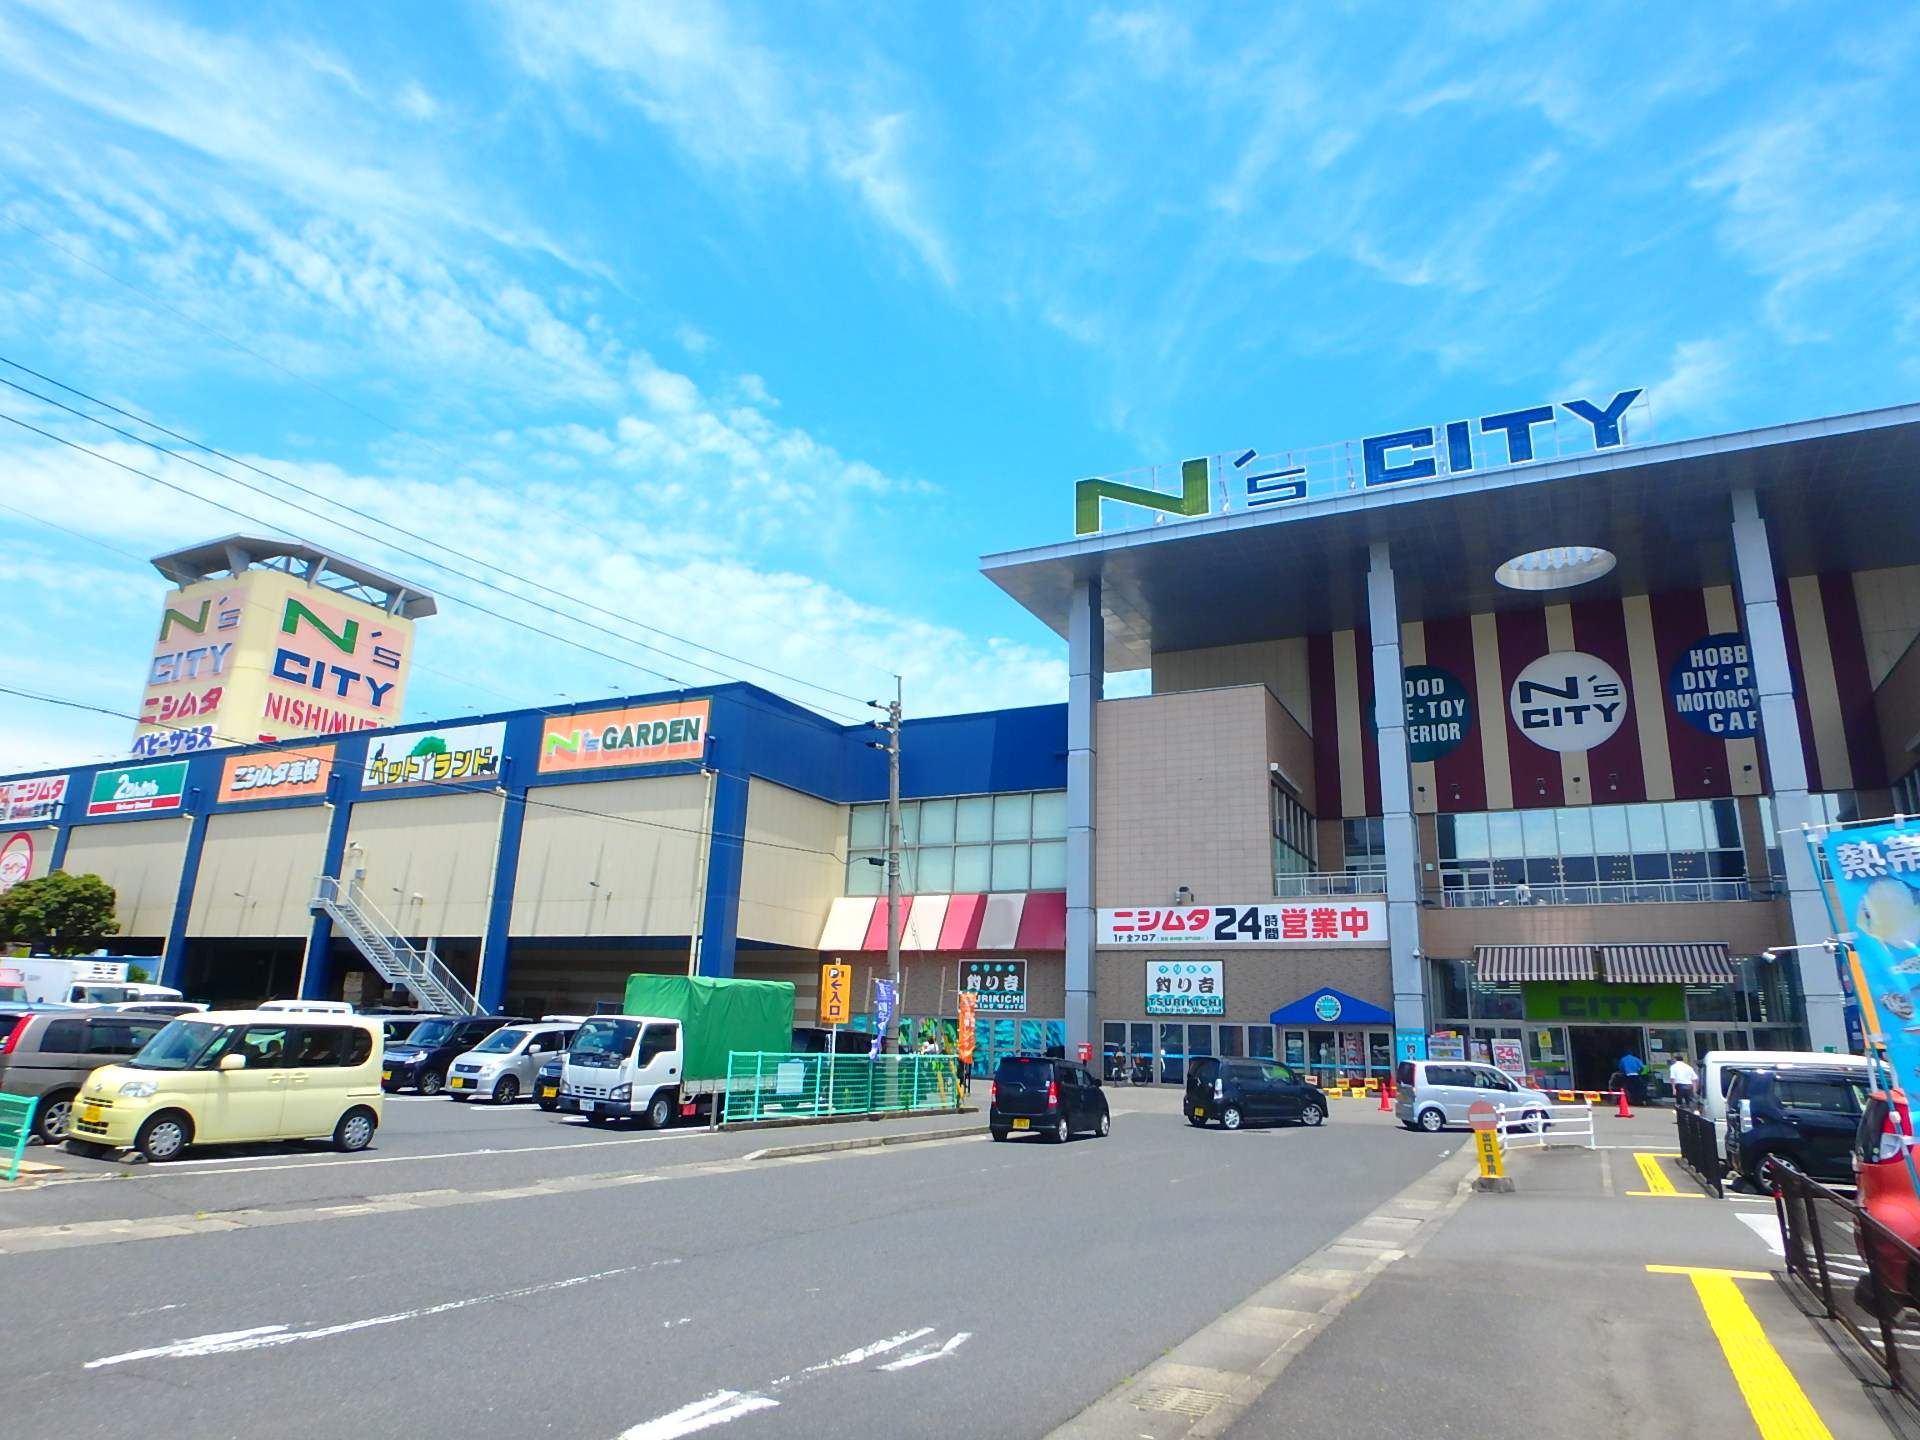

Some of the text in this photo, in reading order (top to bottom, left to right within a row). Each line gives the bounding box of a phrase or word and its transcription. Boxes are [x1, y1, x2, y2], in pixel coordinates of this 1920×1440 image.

[1361, 387, 1646, 488] CITY
[150, 642, 233, 686] CITY
[1690, 645, 1748, 668] HOBB
[271, 647, 395, 707] CITY
[138, 686, 224, 724] ニシムタ
[1521, 701, 1622, 730] CITY
[601, 716, 703, 751] GARDEN
[1708, 710, 1757, 733] CAF
[369, 746, 492, 784] ペットランド
[14, 779, 65, 803] ニシムタ
[1112, 909, 1210, 932] ニシムタ
[829, 991, 842, 1016] 入口
[1148, 997, 1222, 1007] TSURIKICHI
[1559, 996, 1653, 1017] CITY
